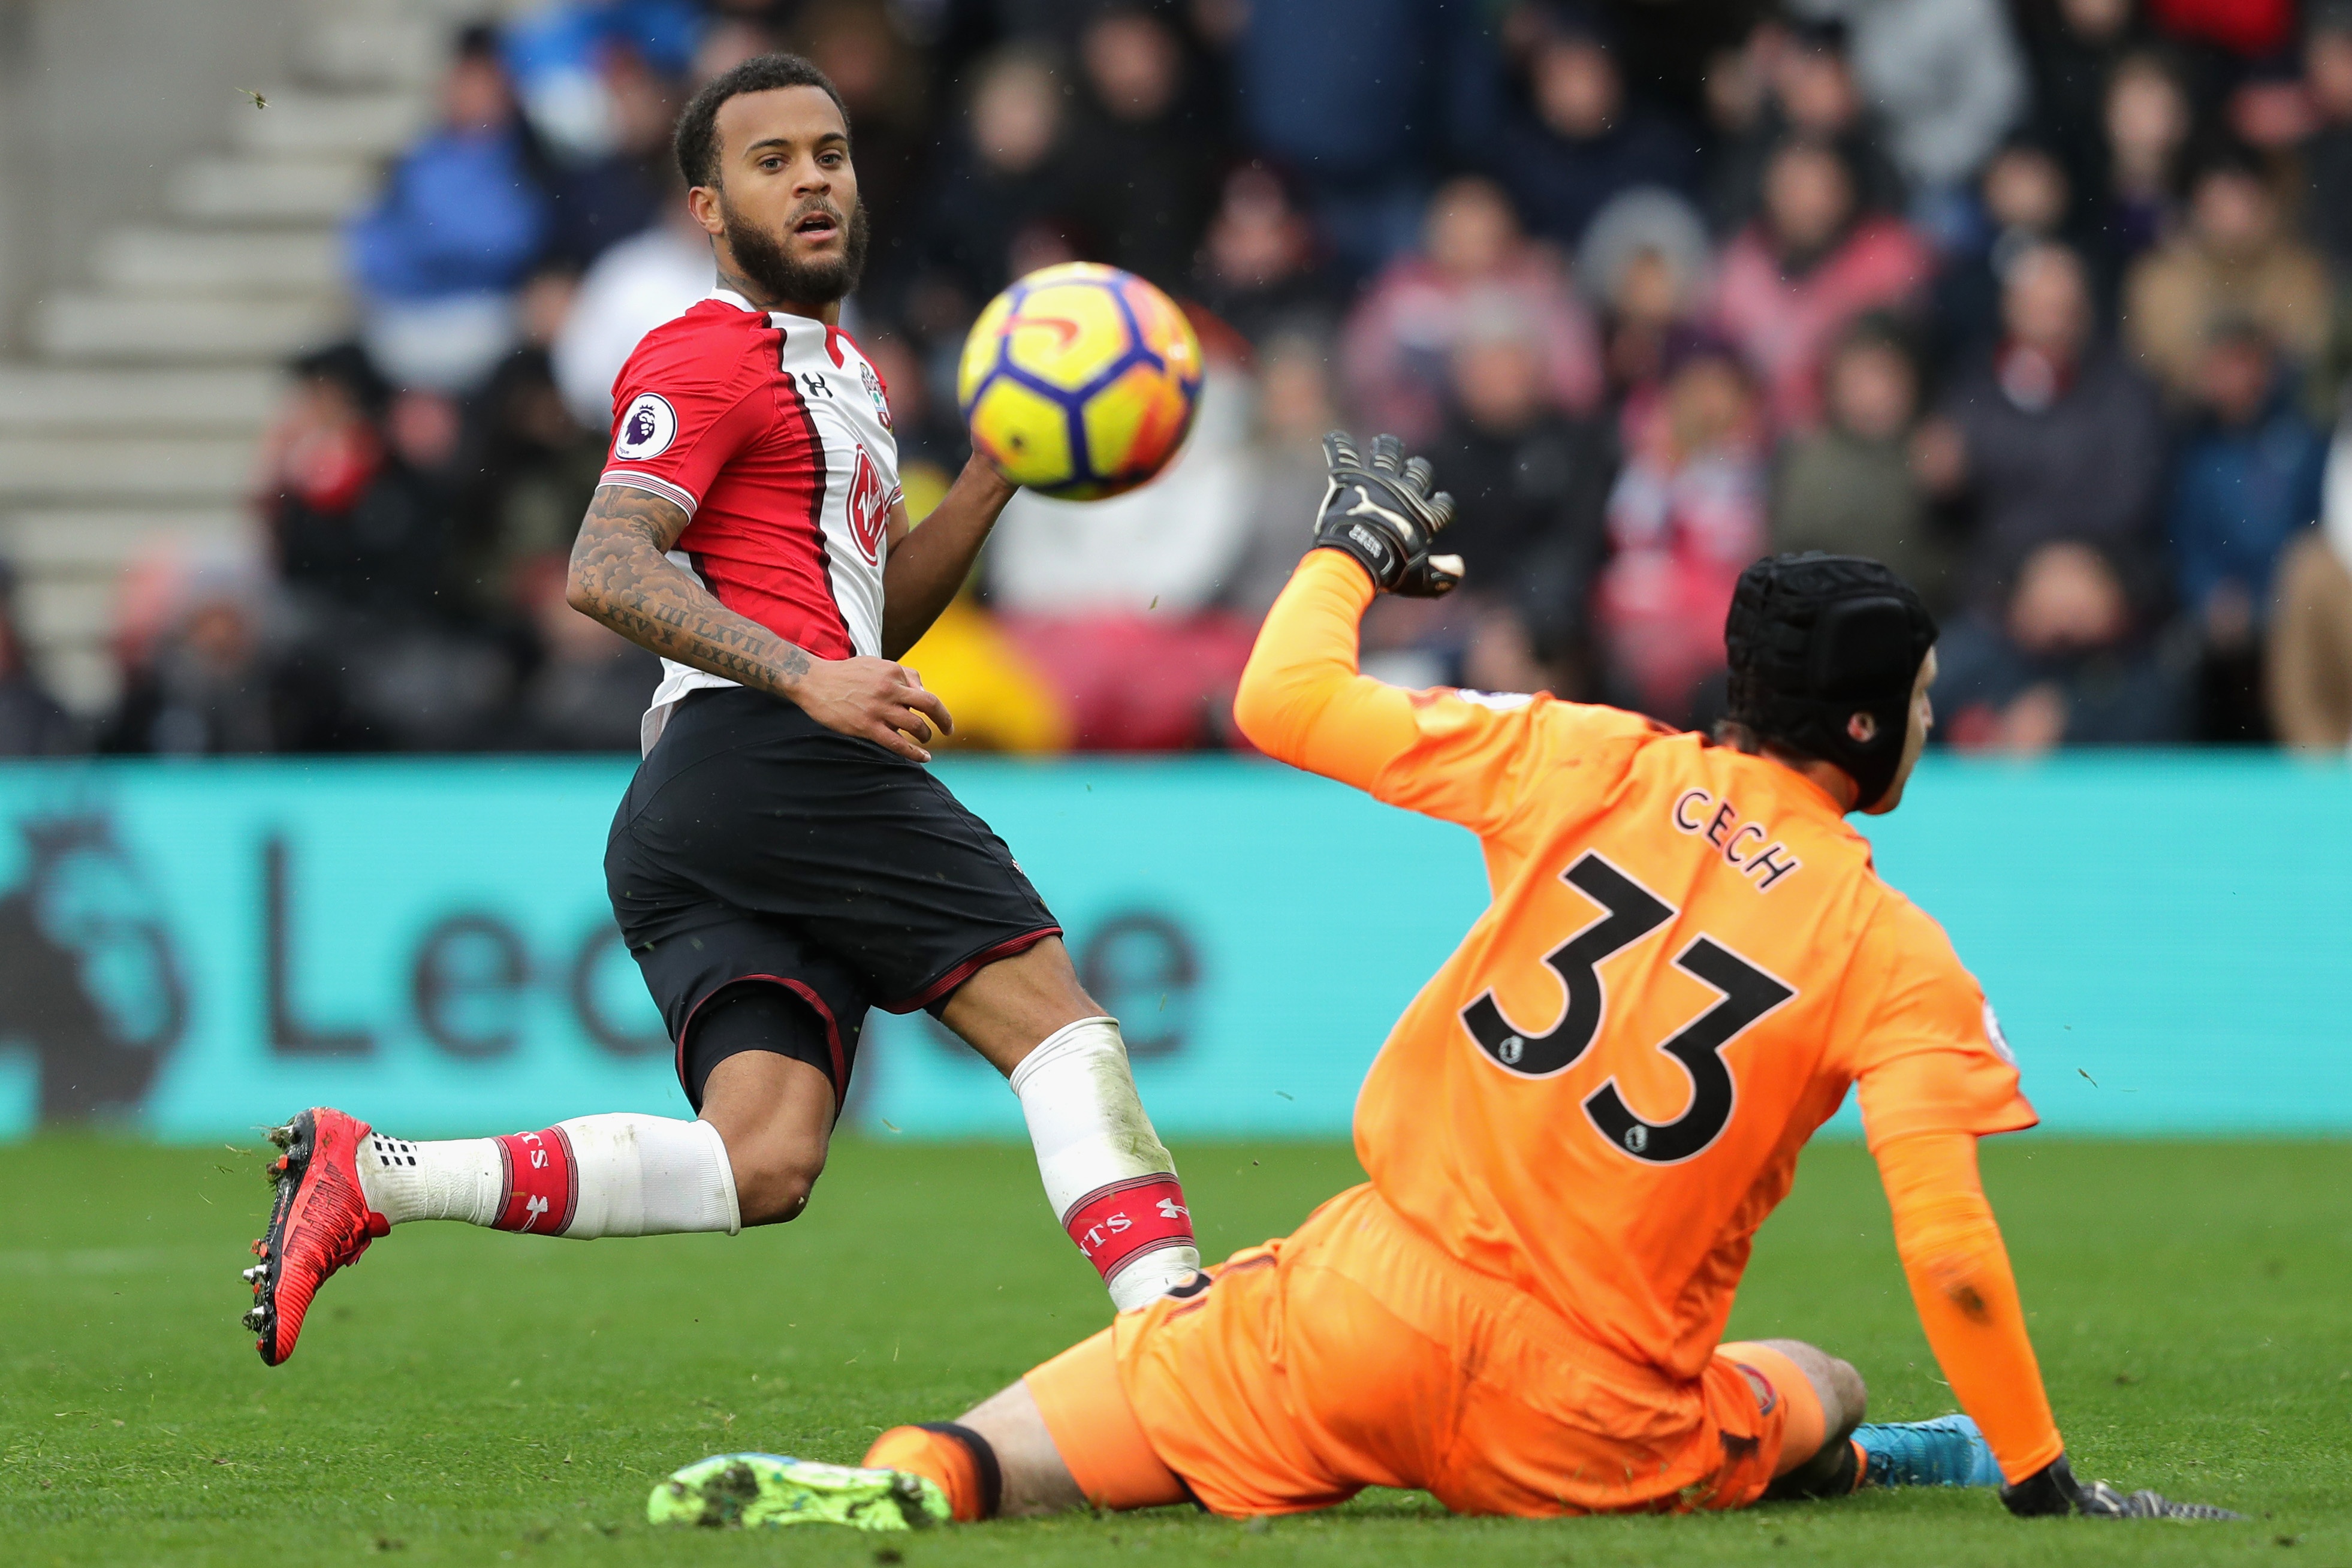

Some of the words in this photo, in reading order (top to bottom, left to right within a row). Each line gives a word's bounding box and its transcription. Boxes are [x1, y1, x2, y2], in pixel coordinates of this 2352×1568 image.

[629, 592, 651, 612] X
[653, 602, 689, 628] III
[1673, 788, 1802, 893] CECH
[261, 833, 1202, 1079] Lee
[1460, 849, 1797, 1165] 33
